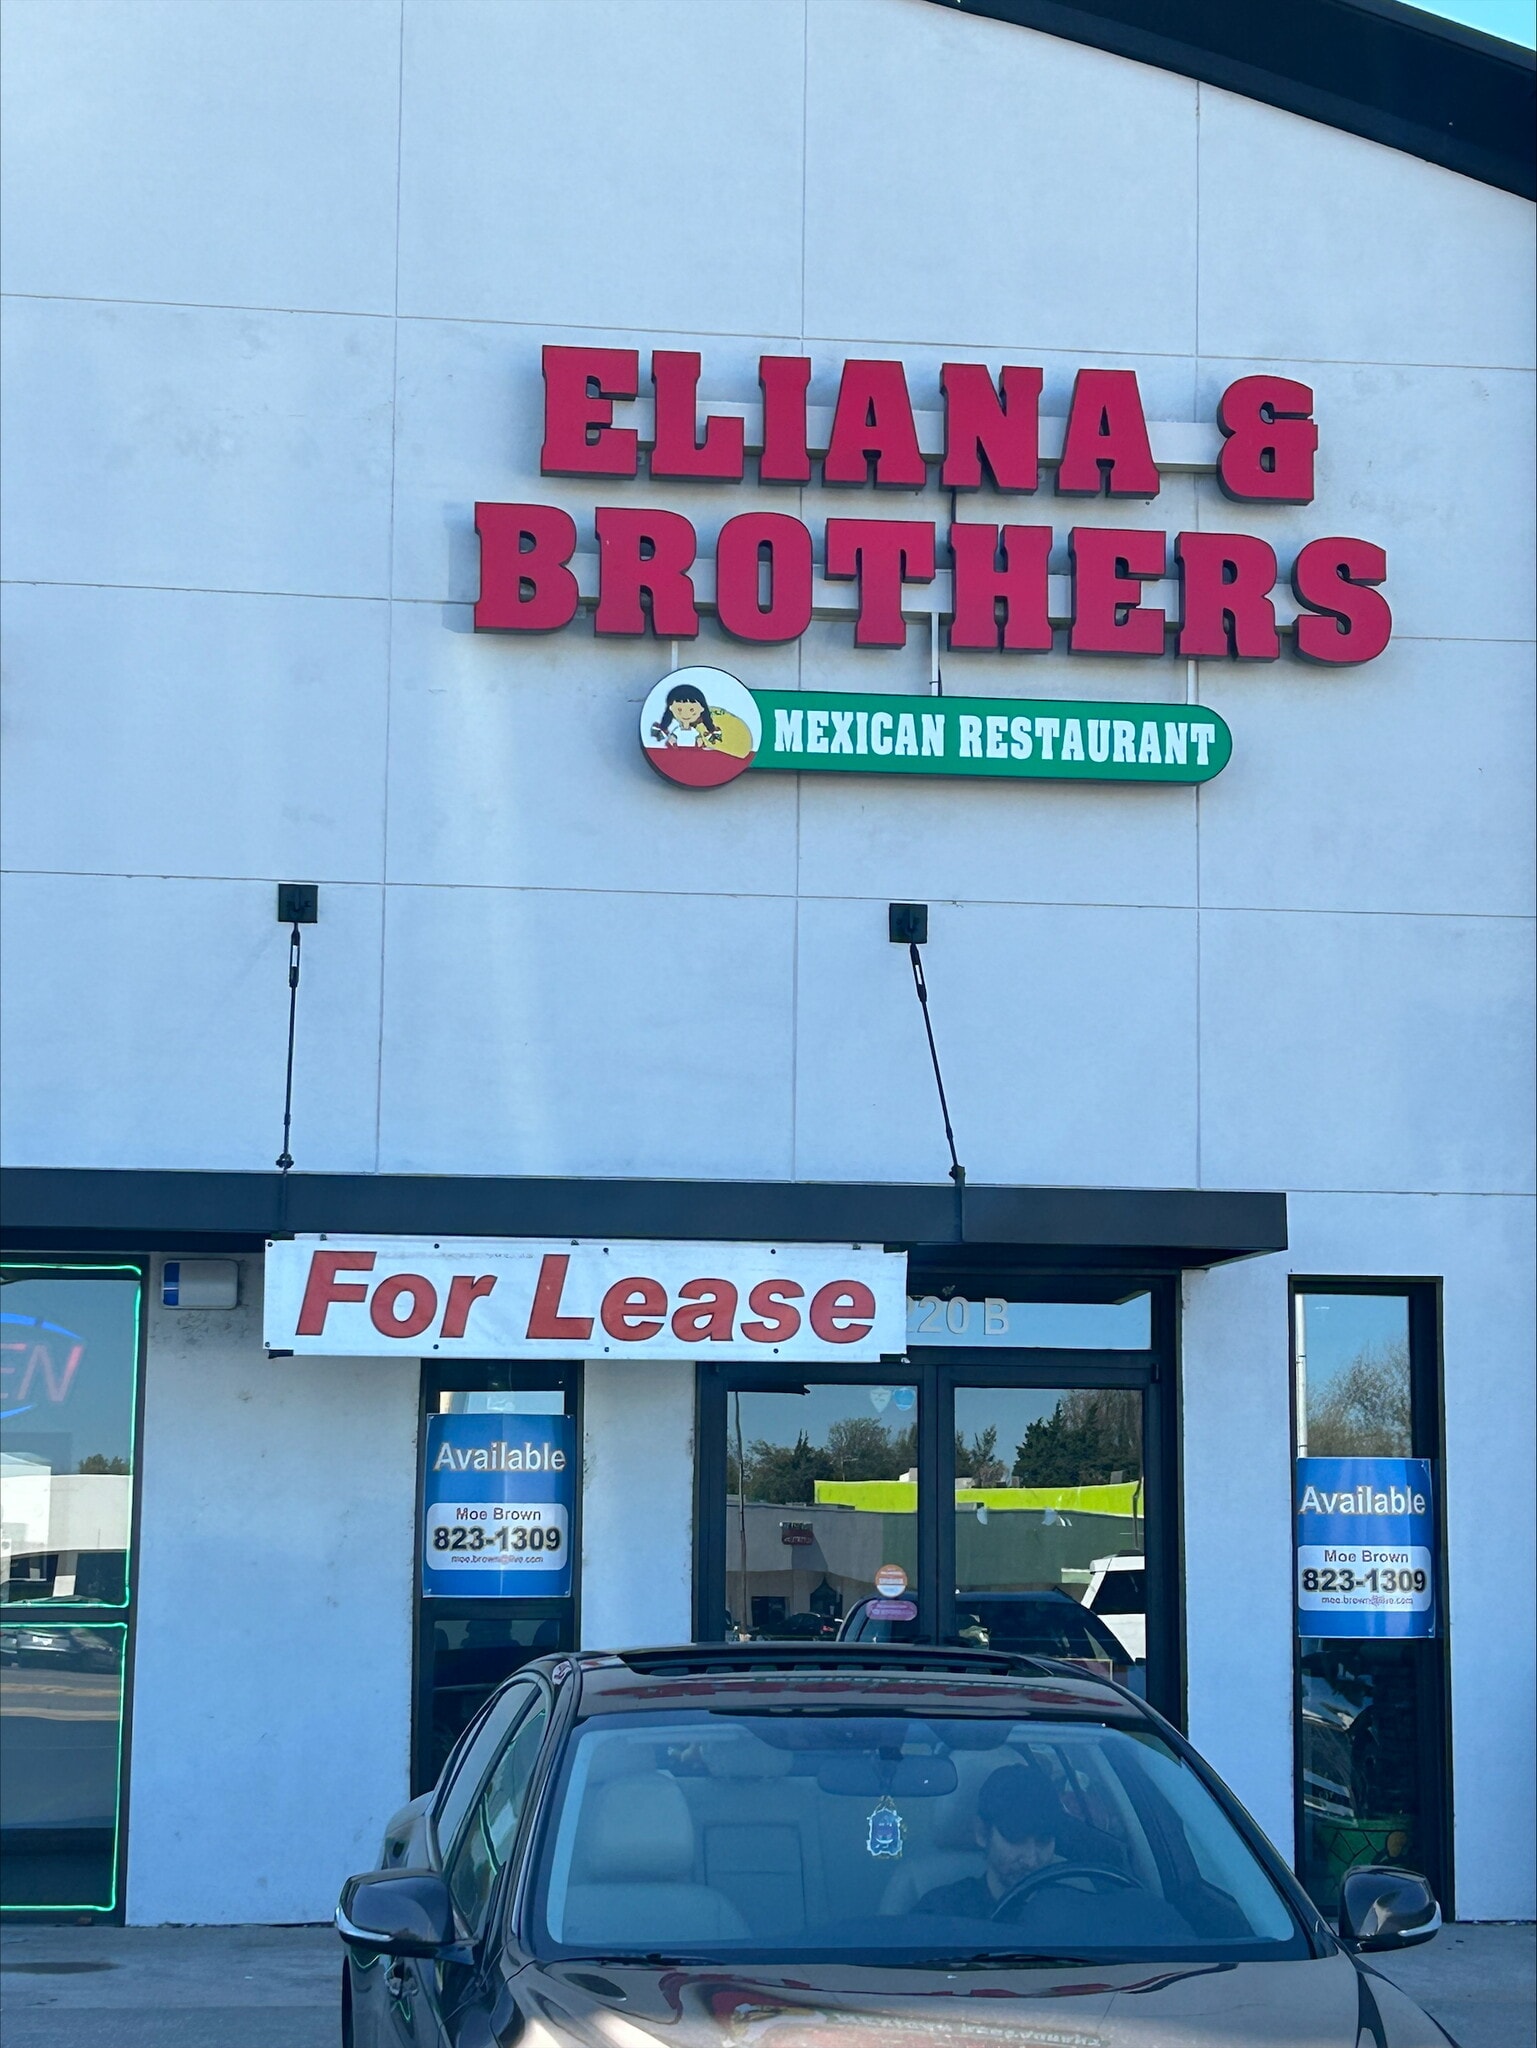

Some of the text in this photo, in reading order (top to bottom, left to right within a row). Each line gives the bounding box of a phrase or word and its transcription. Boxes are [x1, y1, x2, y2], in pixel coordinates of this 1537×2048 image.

[540, 344, 1318, 506] ELIANA &
[473, 501, 1394, 668] BROTHERS
[774, 708, 1216, 766] MEXICAN RESTAURANT
[295, 1250, 876, 1344] For Lease
[984, 1297, 1009, 1335] B
[433, 1441, 566, 1472] Available
[456, 1507, 541, 1521] Moe Brown
[1299, 1485, 1426, 1515] Available
[433, 1526, 561, 1551] 823-1309
[1324, 1549, 1409, 1563] Moe Brown
[1303, 1568, 1427, 1593] 823-1309
